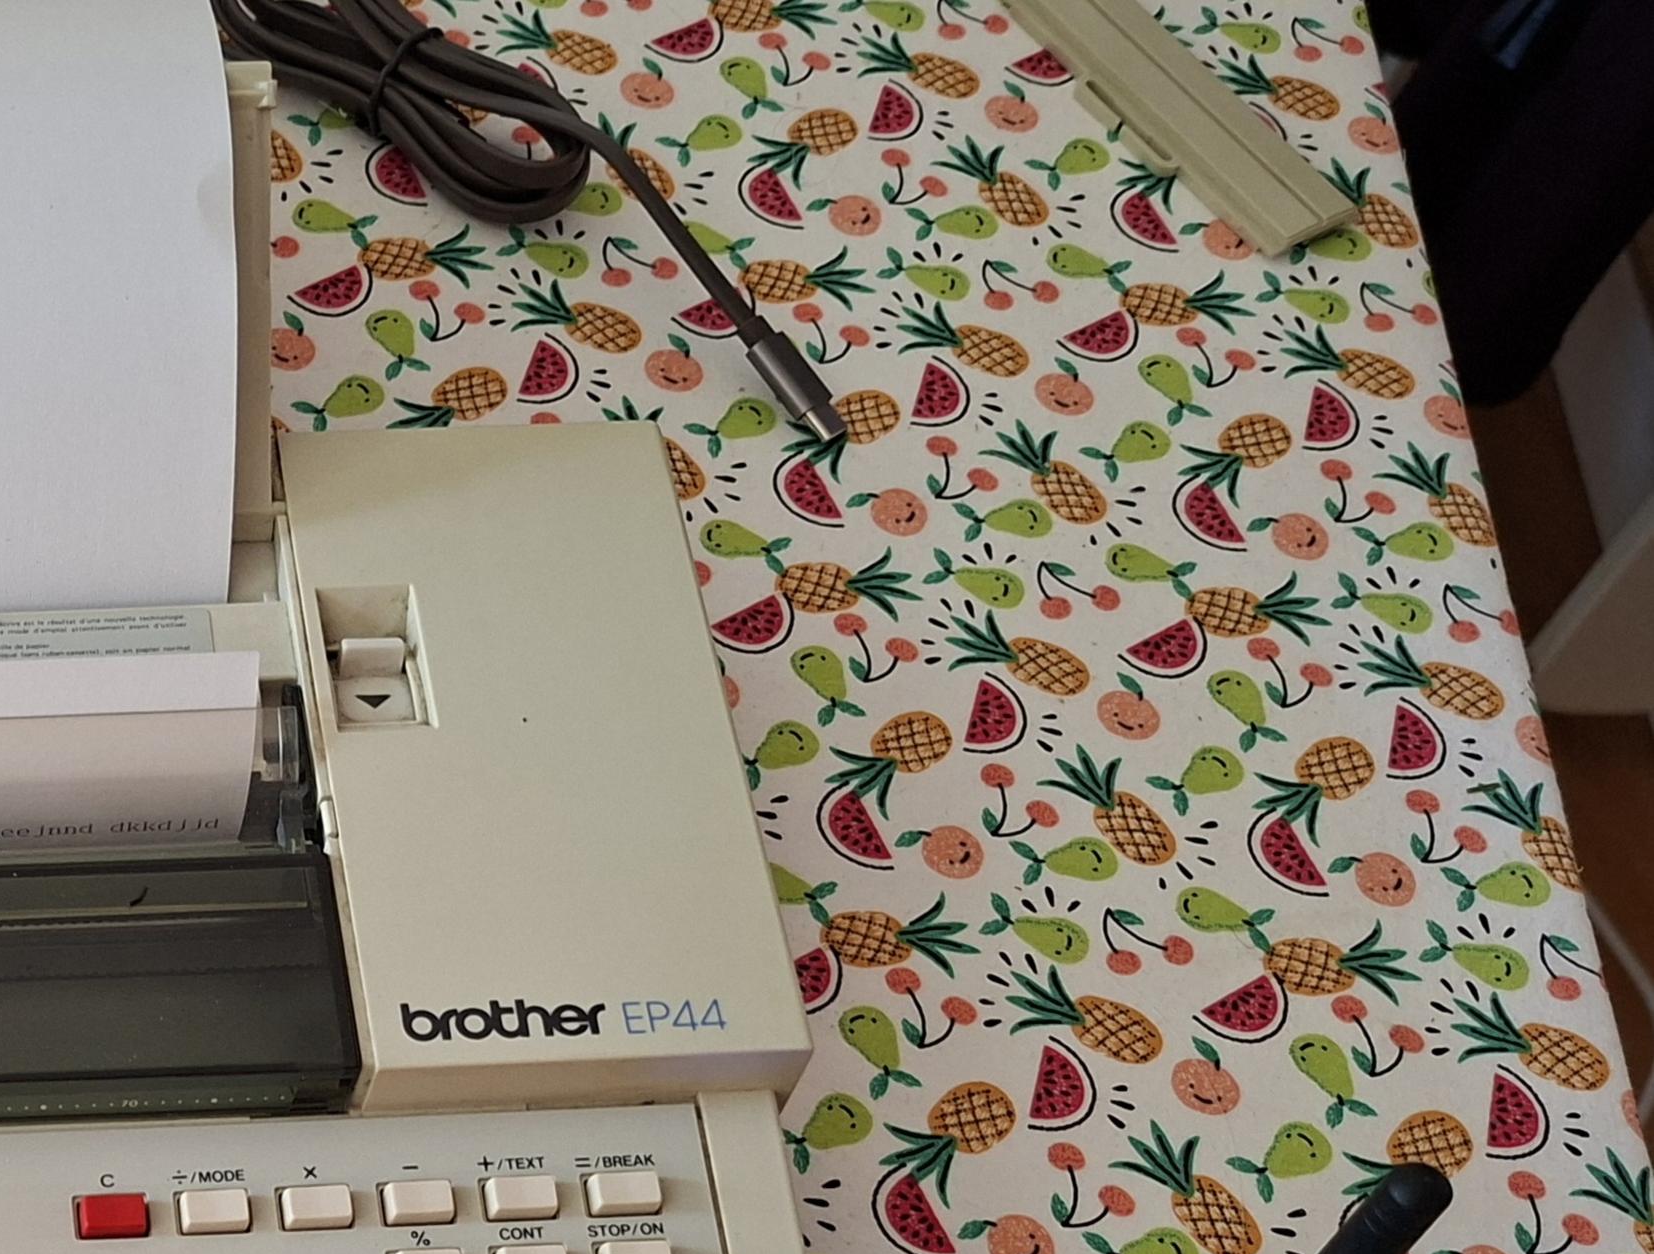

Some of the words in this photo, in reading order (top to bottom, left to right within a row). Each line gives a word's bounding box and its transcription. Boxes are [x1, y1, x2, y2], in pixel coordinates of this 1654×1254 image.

[399, 999, 606, 1042] brother
[621, 998, 728, 1034] EP44
[476, 1156, 546, 1173] +/TEXT
[575, 1153, 655, 1169] =/BREAK
[99, 1173, 115, 1189] C
[499, 1226, 544, 1241] CONT
[588, 1221, 665, 1238] STOP/ON
[410, 1231, 431, 1247] %
